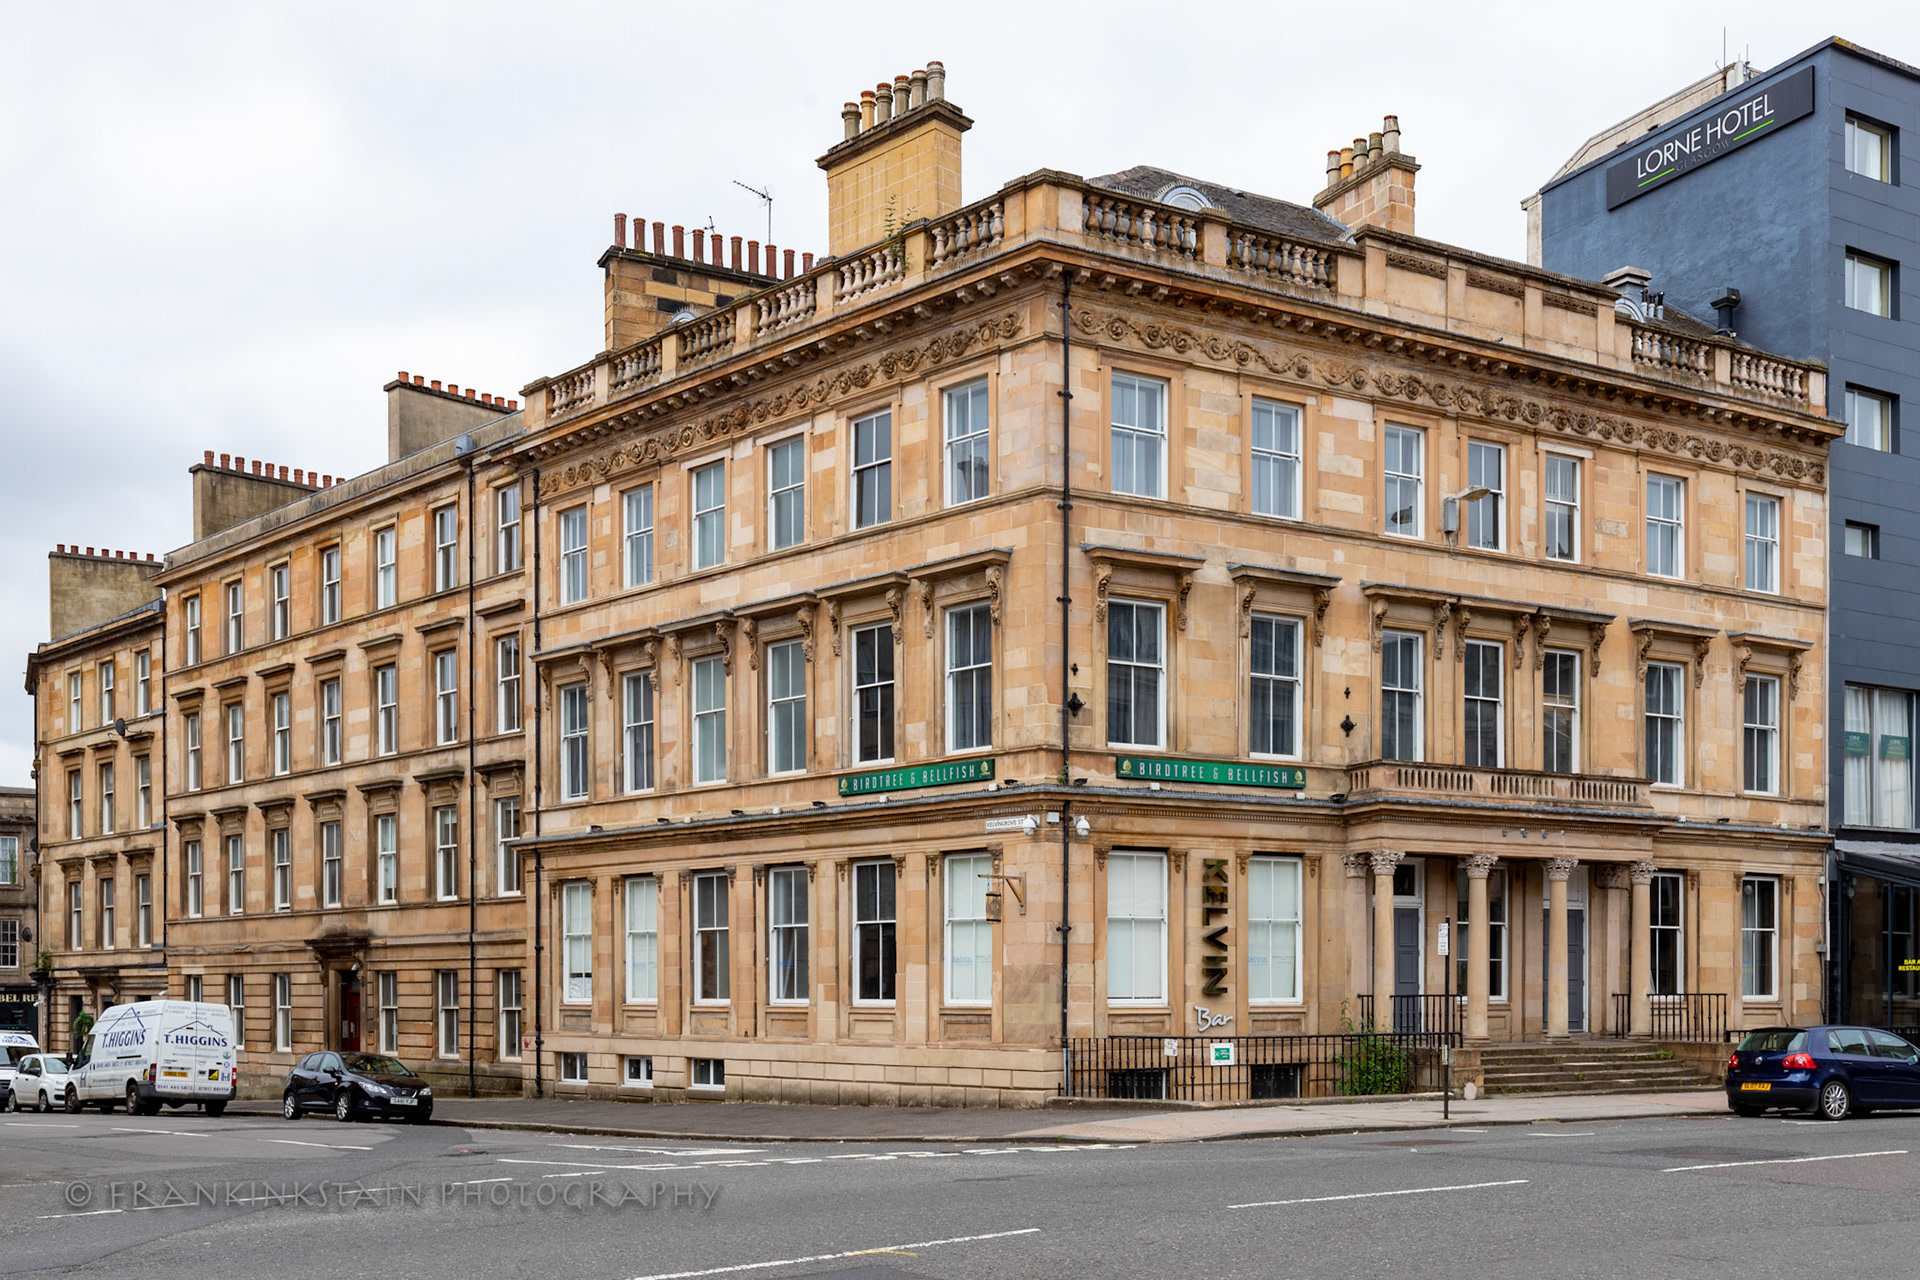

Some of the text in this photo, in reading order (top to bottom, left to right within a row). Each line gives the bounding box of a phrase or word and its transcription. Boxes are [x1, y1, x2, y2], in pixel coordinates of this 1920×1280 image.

[1637, 94, 1775, 179] LORNE HOTEL
[1675, 139, 1731, 172] GLASGOW
[853, 773, 903, 791] BIRDTREE
[922, 764, 975, 783] BELLFISH
[1139, 762, 1204, 780] BIRDTREE
[1228, 768, 1288, 784] BELLFISH
[1202, 858, 1228, 996] KELVIN
[1194, 1005, 1234, 1032] Bar
[102, 1029, 147, 1049] T.HIGGINS
[163, 1034, 228, 1047] T.HIGGINS
